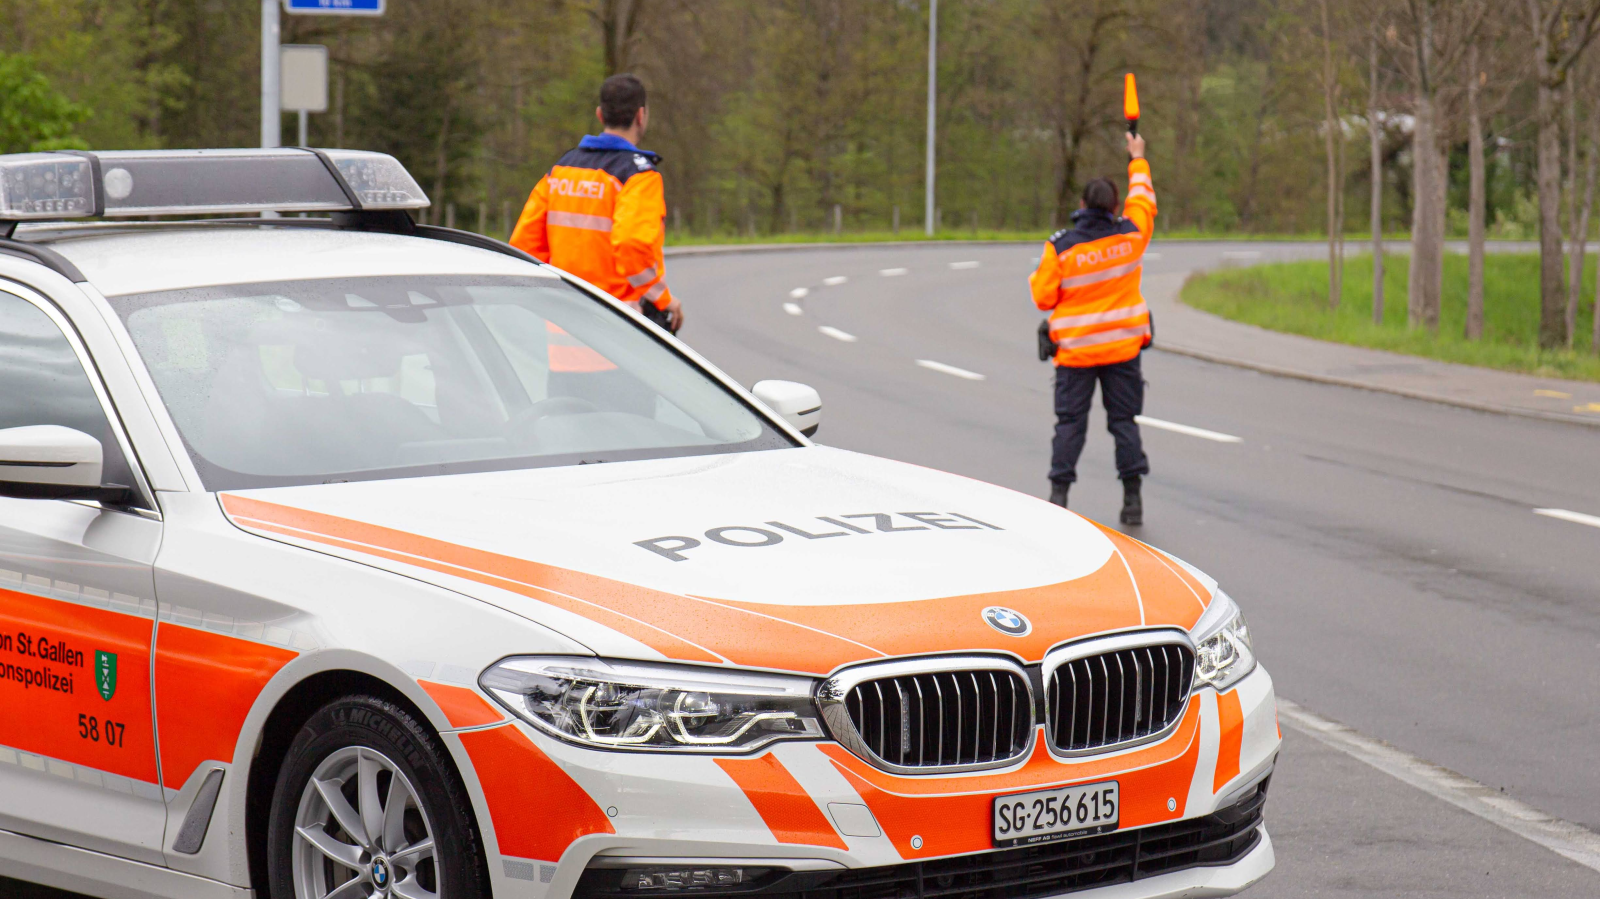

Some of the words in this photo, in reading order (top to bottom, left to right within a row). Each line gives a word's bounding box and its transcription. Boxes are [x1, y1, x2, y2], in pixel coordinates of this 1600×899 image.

[547, 177, 605, 199] POLIZEI
[1076, 241, 1133, 267] POLIZEI
[632, 511, 1006, 562] POLIZEI
[78, 713, 100, 742] 58
[105, 720, 126, 748] 07
[349, 708, 424, 769] MICHELIN
